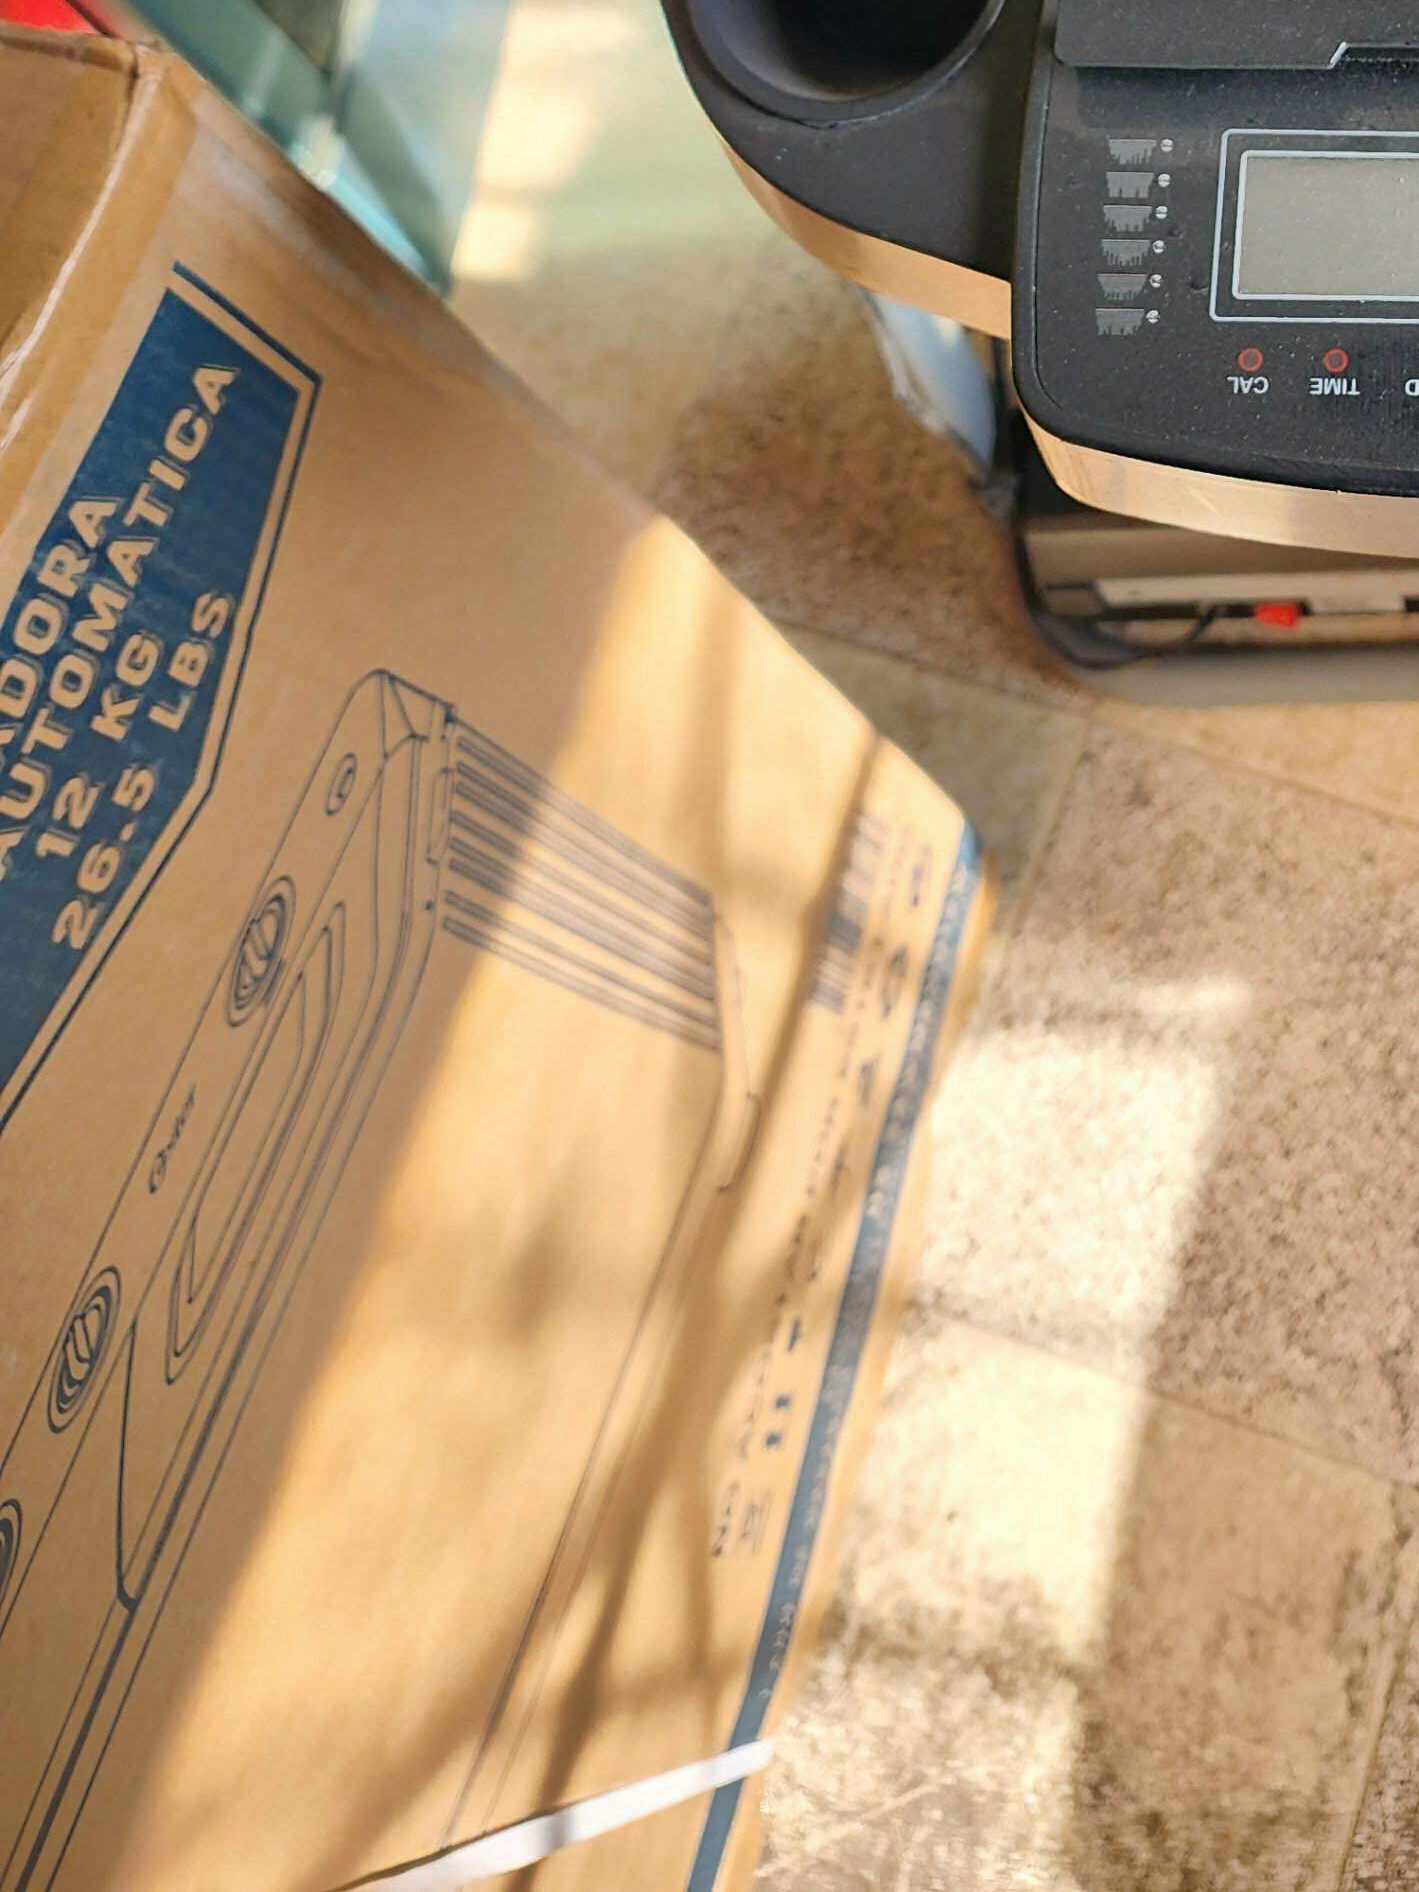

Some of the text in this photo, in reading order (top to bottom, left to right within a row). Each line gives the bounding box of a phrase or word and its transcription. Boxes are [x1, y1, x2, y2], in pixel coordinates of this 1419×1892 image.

[1227, 375, 1269, 395] CAL
[1310, 377, 1361, 397] TIME
[36, 629, 165, 860] 12 KG
[52, 590, 236, 950] 26.5 LBS
